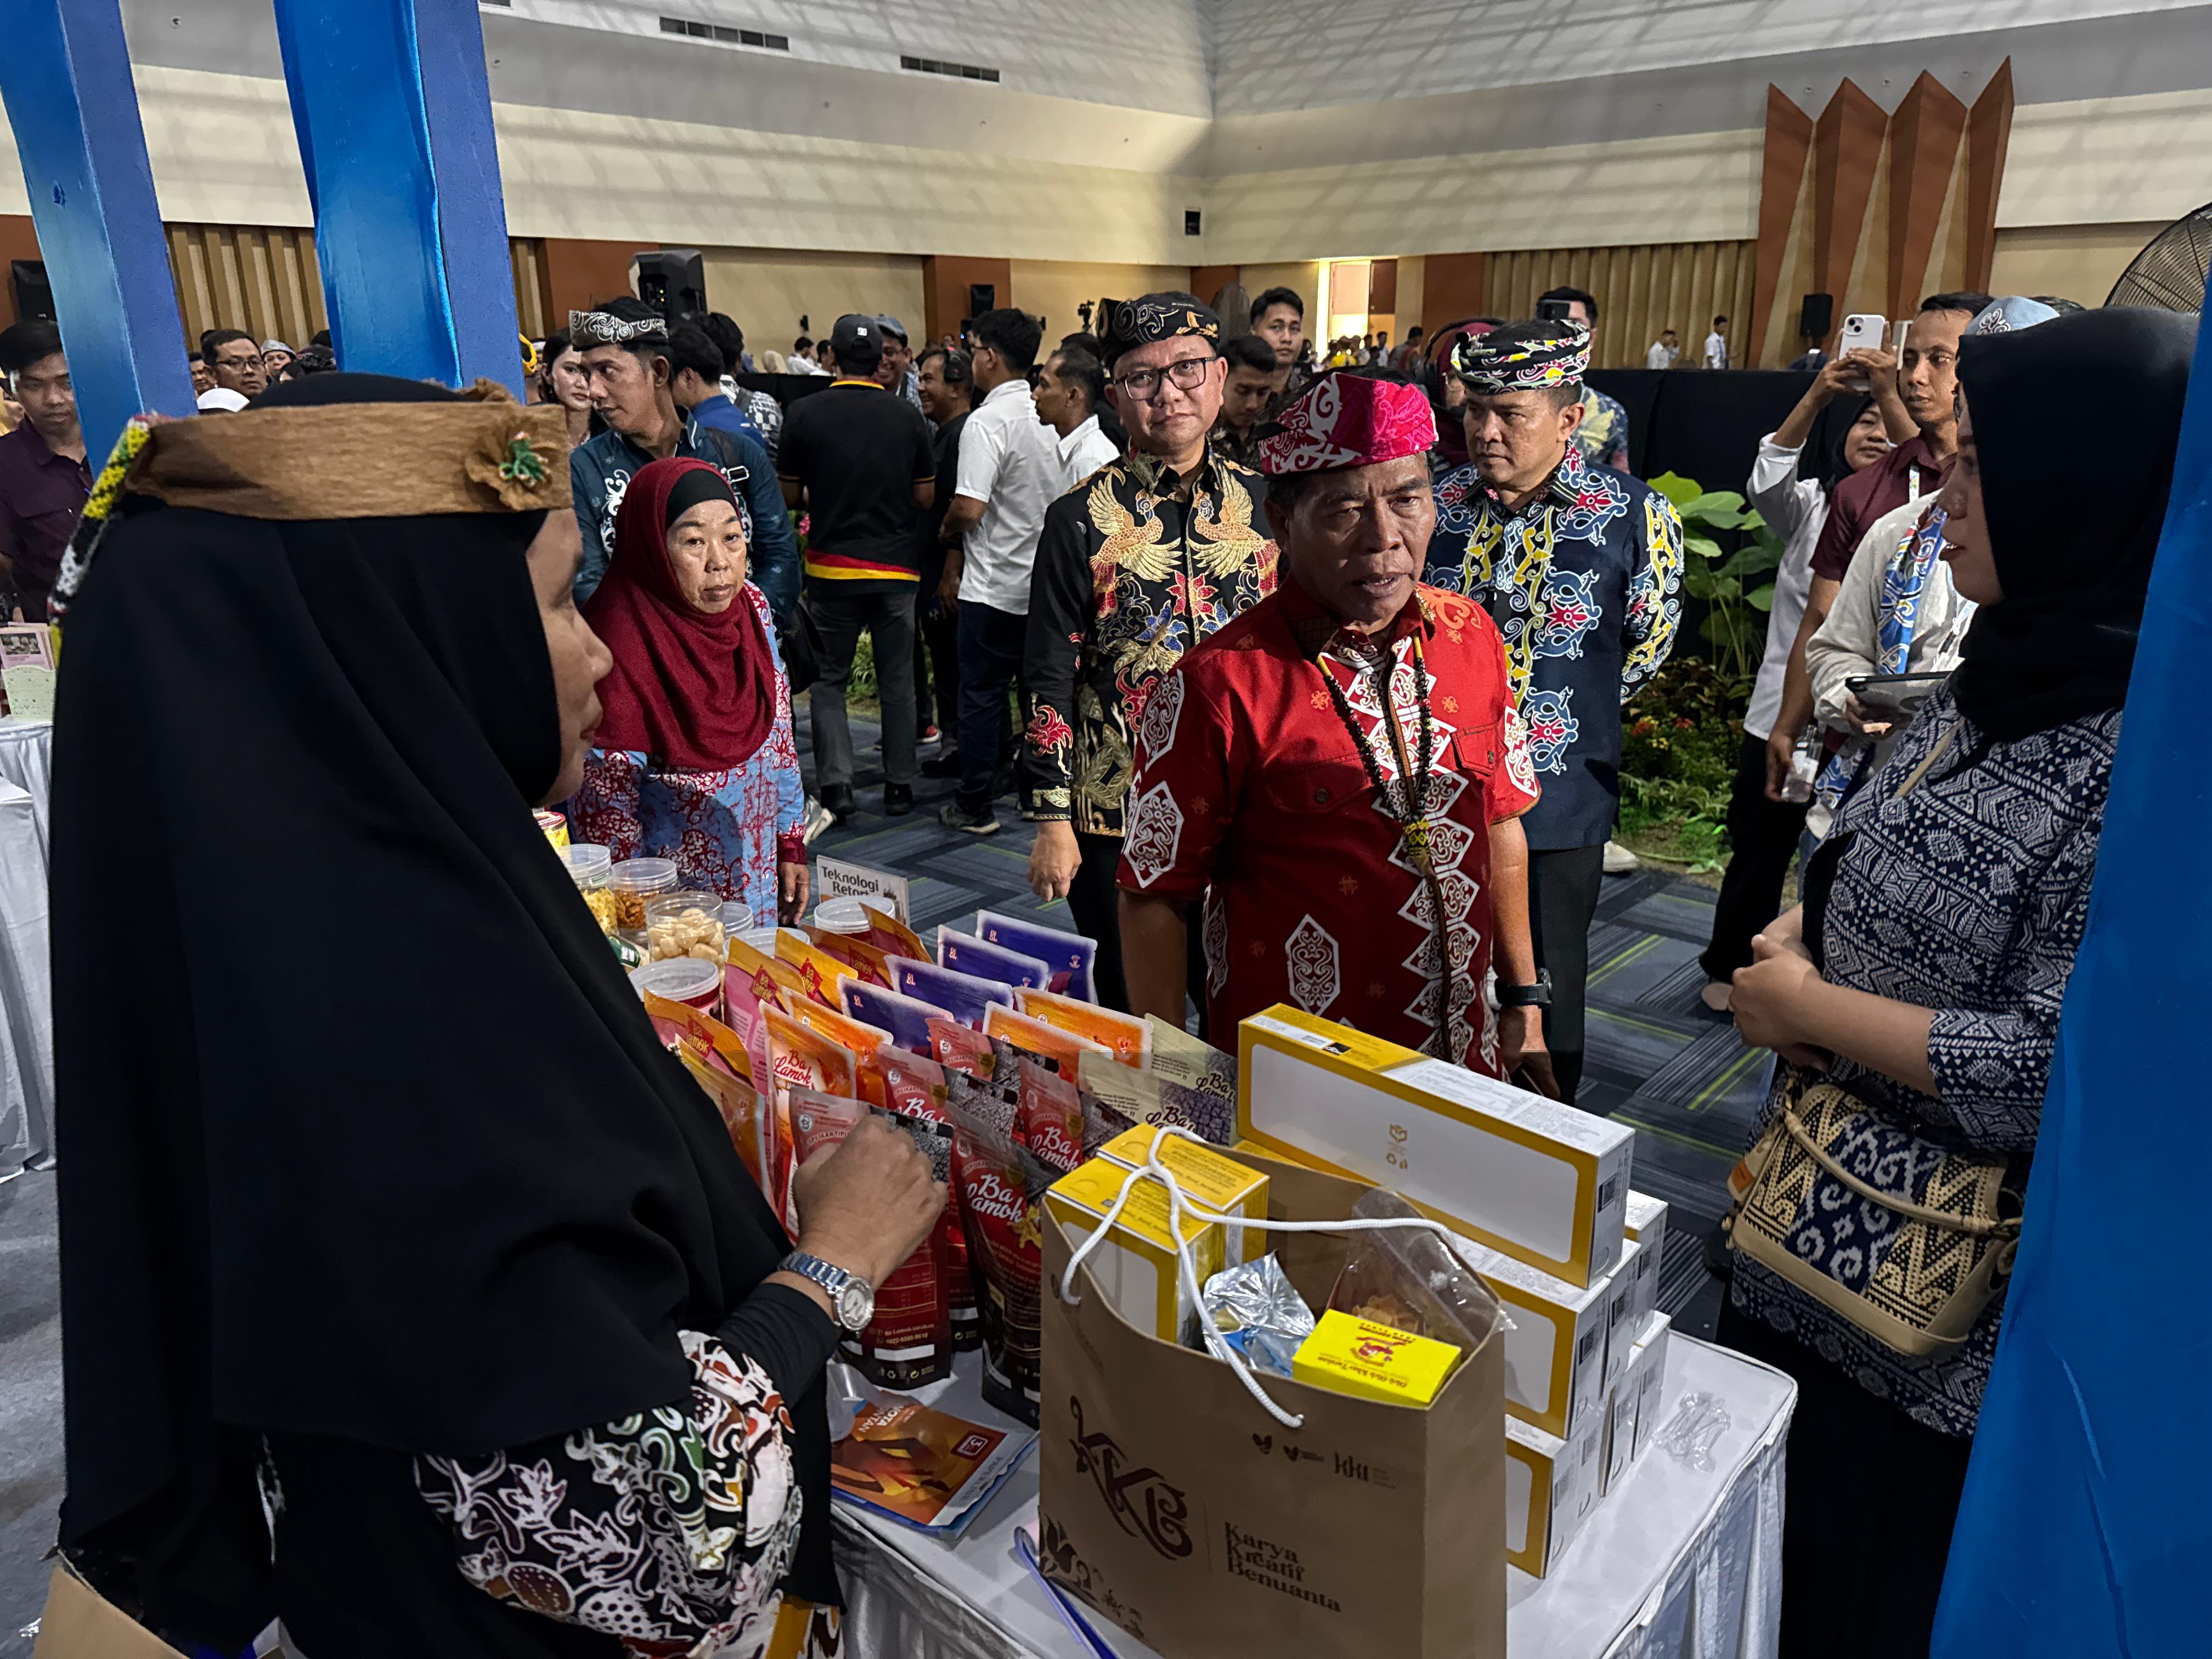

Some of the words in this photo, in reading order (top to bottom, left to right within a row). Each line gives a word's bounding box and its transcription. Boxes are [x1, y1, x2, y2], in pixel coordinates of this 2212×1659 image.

[821, 866, 879, 893] Teknologi
[774, 1056, 812, 1085] Lamok
[788, 1048, 807, 1070] Ba
[1210, 1073, 1229, 1093] Ba
[1163, 1105, 1188, 1127] Ba
[1044, 1126, 1072, 1155] Ba
[978, 1173, 1014, 1203] Ba
[1225, 1521, 1299, 1564] Karya
[1227, 1539, 1306, 1583] Kreatif
[1228, 1557, 1342, 1613] Benuanta
